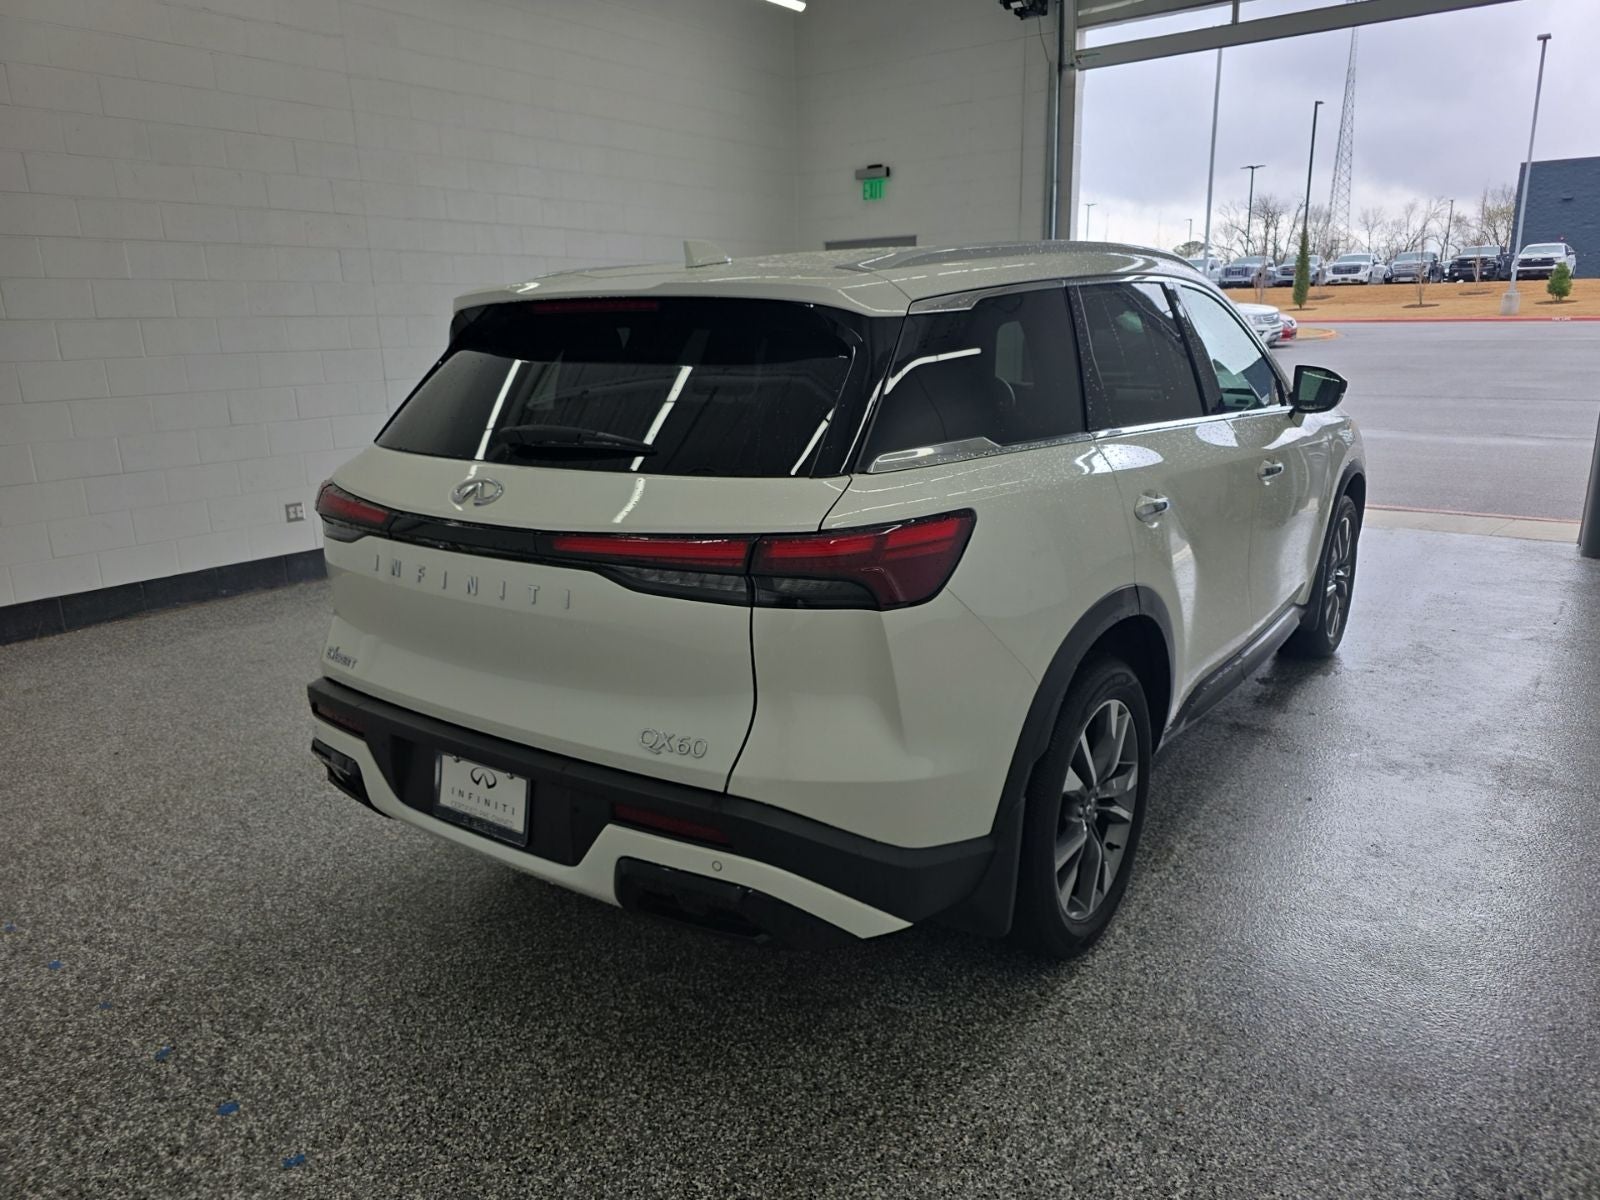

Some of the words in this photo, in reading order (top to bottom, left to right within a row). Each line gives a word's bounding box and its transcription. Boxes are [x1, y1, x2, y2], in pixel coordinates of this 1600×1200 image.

[863, 178, 885, 200] EXIT
[374, 553, 571, 610] INFINITI
[639, 727, 708, 759] QX60
[450, 786, 516, 816] INFINITI
